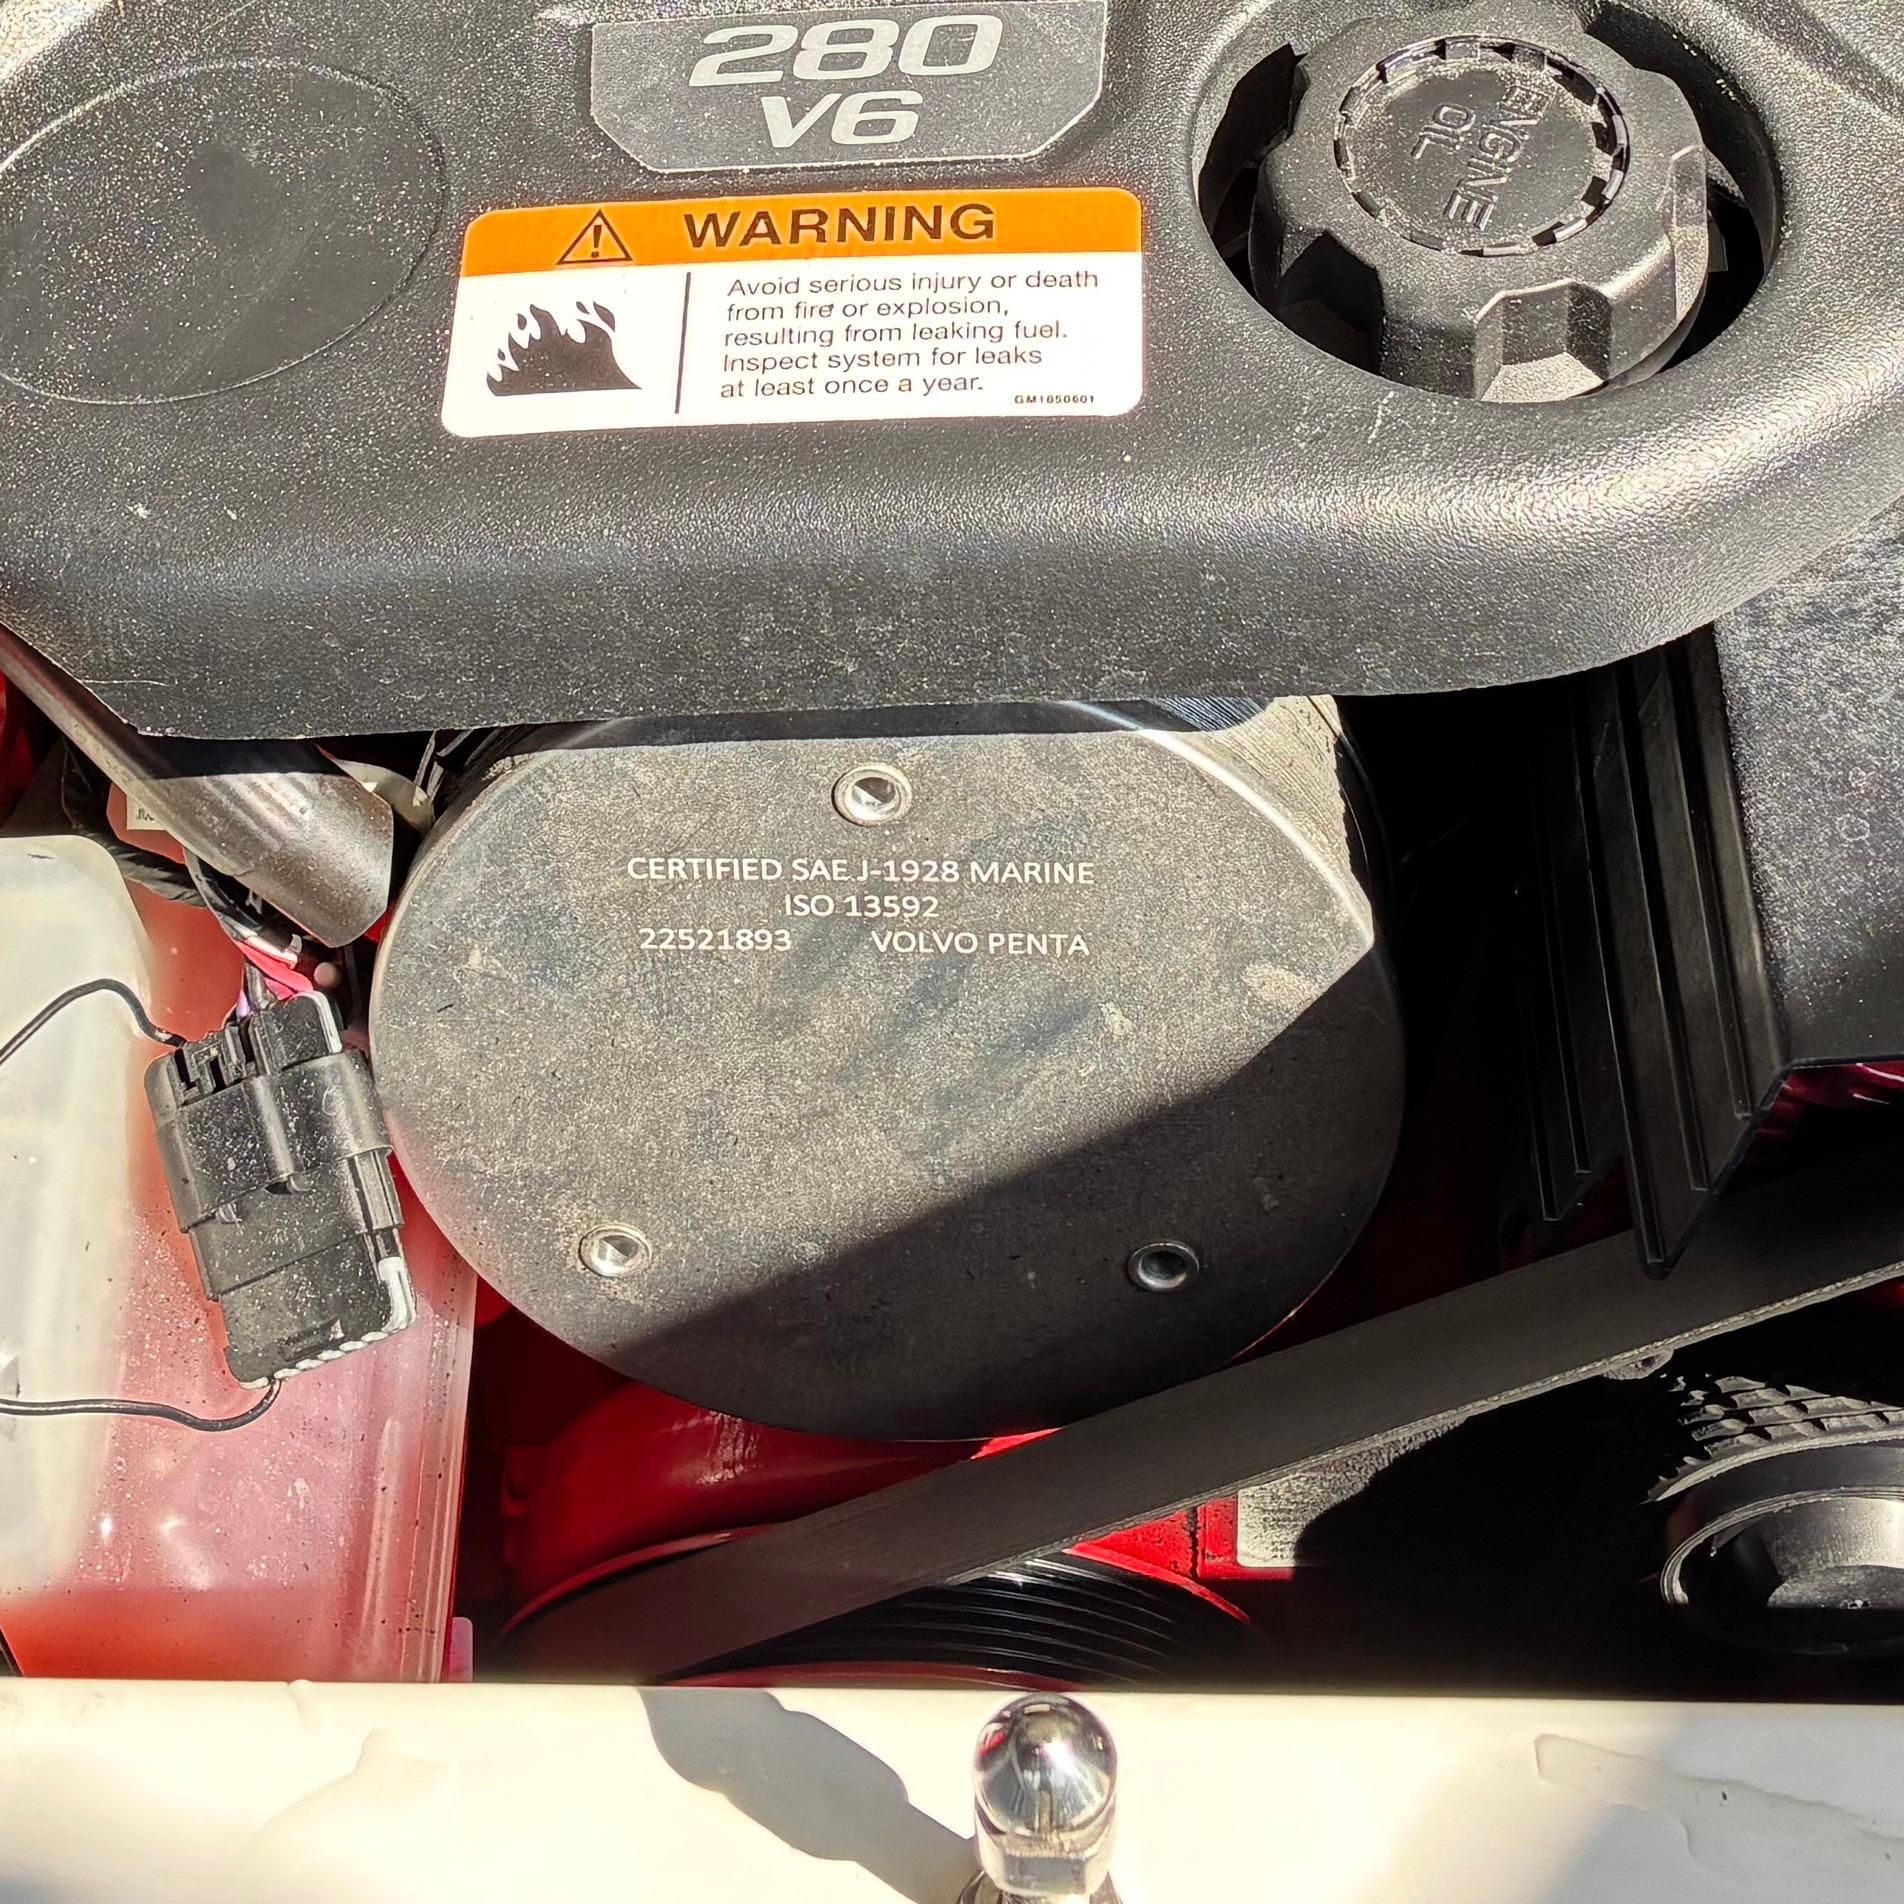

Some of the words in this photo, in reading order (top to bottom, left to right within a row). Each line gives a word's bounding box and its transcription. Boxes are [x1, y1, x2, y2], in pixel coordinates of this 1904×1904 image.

[689, 13, 1003, 87] 280
[759, 91, 925, 149] V6
[1410, 100, 1478, 161] OIL
[1442, 84, 1556, 232] ENGINE
[683, 203, 997, 250] WARNING
[727, 277, 800, 296] Avoid
[809, 274, 903, 293] serious
[912, 272, 982, 294] injury
[990, 275, 1017, 289] or
[1025, 271, 1099, 288] death
[727, 303, 784, 321] from
[795, 301, 835, 318] fire
[842, 304, 869, 317] or
[876, 298, 1009, 318] explosion,
[724, 328, 834, 348] resulting
[845, 325, 902, 342] from
[912, 322, 1004, 343] leaking
[1014, 320, 1068, 339] fuel.
[723, 352, 818, 375] Inspect
[827, 350, 921, 372] system
[932, 347, 967, 365] for
[975, 346, 1043, 365] leaks
[720, 380, 745, 397] at
[754, 379, 815, 396] least
[824, 378, 889, 394] once
[898, 377, 913, 392] a
[922, 376, 984, 395] year.
[627, 857, 782, 881] CERTIFIED
[792, 860, 847, 882] SAE
[856, 859, 960, 883] J-1928
[969, 861, 1095, 884] MARINE
[785, 894, 835, 917] ISO
[845, 895, 940, 918] 13592
[639, 927, 793, 952] 22521893
[871, 929, 978, 955] VOLVO
[989, 933, 1090, 957] PENTA
